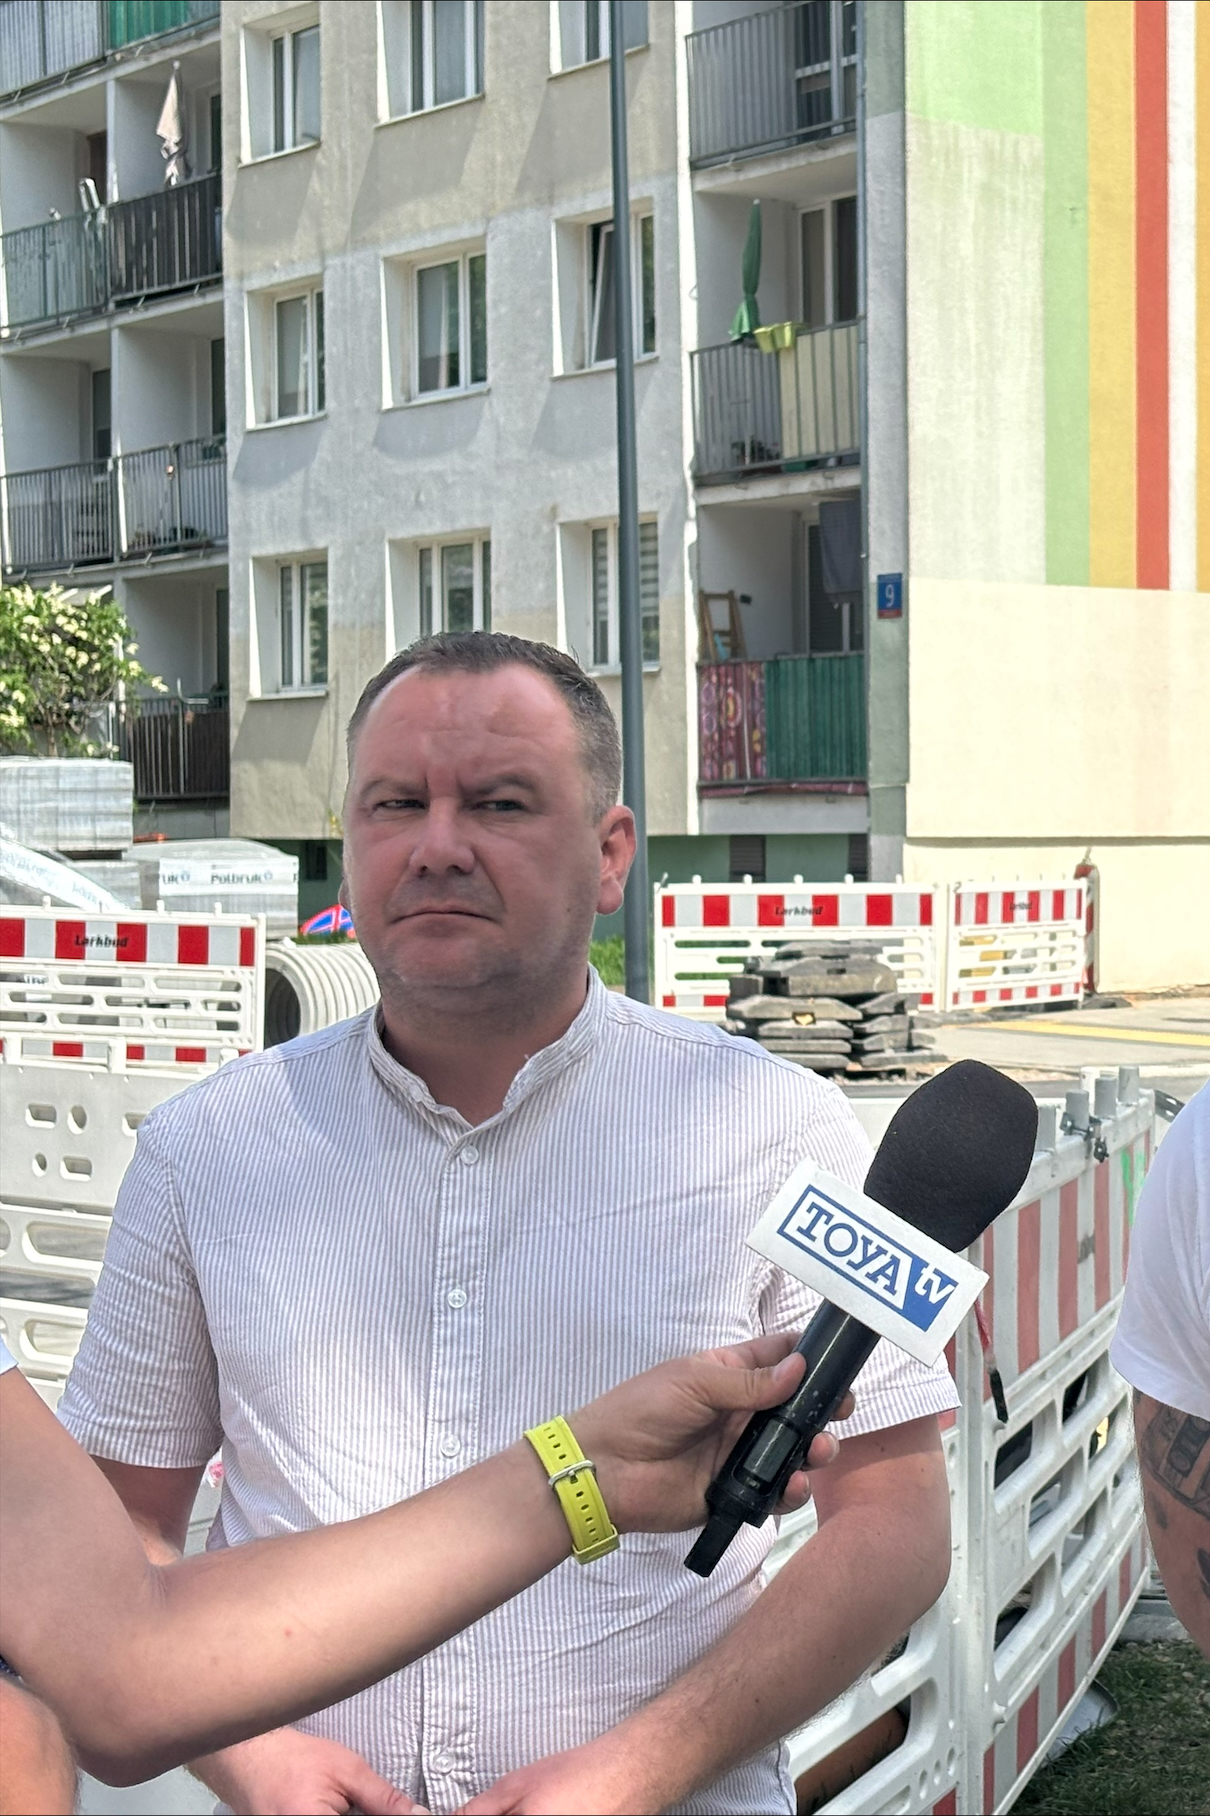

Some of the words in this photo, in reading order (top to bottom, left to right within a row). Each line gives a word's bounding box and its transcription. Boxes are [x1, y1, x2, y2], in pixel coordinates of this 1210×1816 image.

[885, 583, 895, 608] 9
[210, 872, 262, 885] Polbruk
[796, 1201, 902, 1297] TOYA
[914, 1266, 957, 1305] tv
